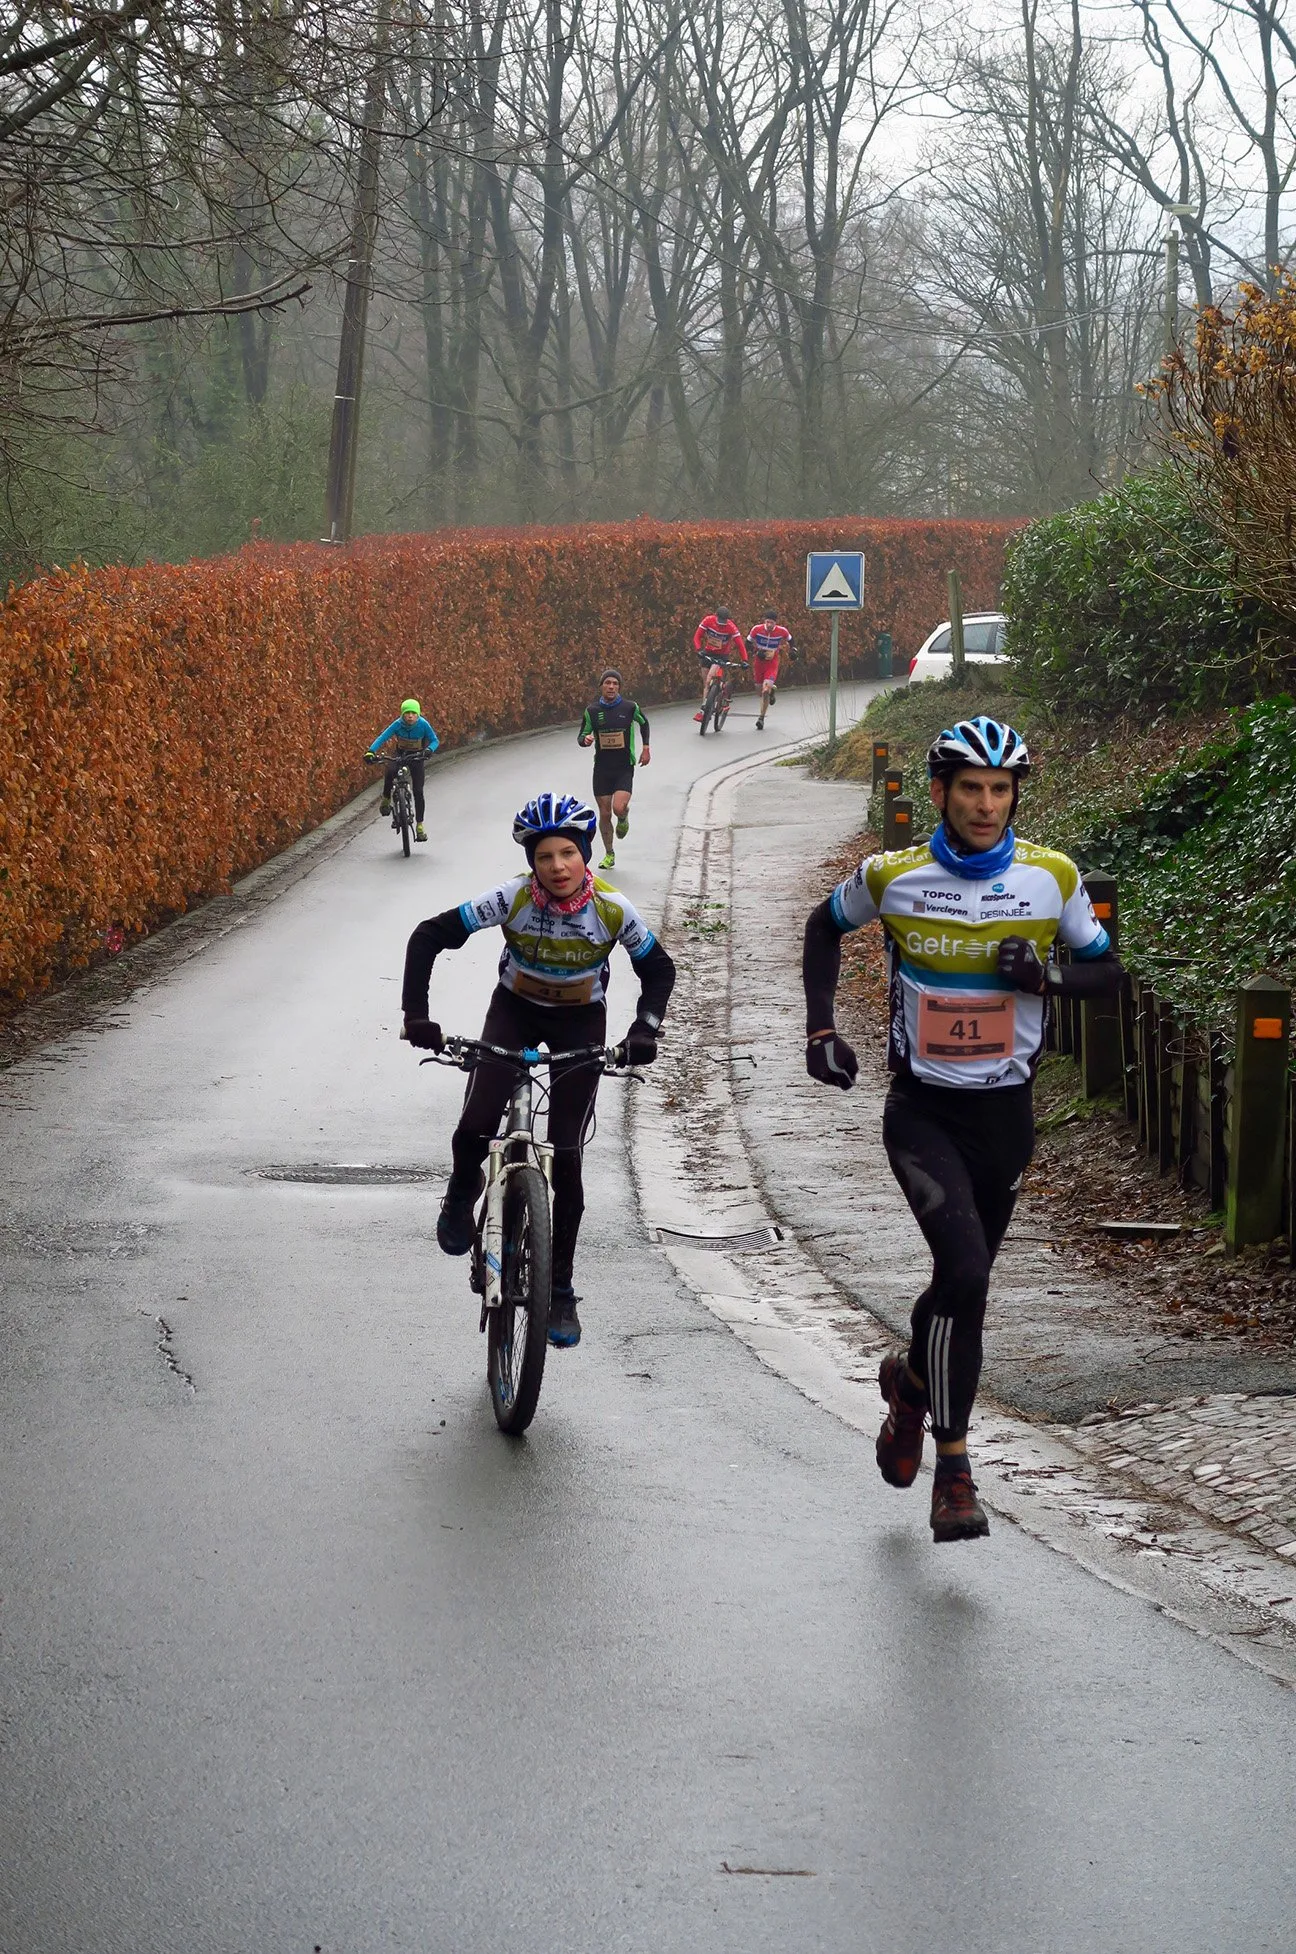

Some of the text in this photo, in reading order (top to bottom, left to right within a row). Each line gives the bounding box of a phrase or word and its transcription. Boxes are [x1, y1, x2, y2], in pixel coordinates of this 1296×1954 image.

[886, 851, 934, 866] Crelan
[922, 890, 962, 902] TOPCO
[926, 903, 968, 916] Vercleyen
[949, 1018, 982, 1041] 41
